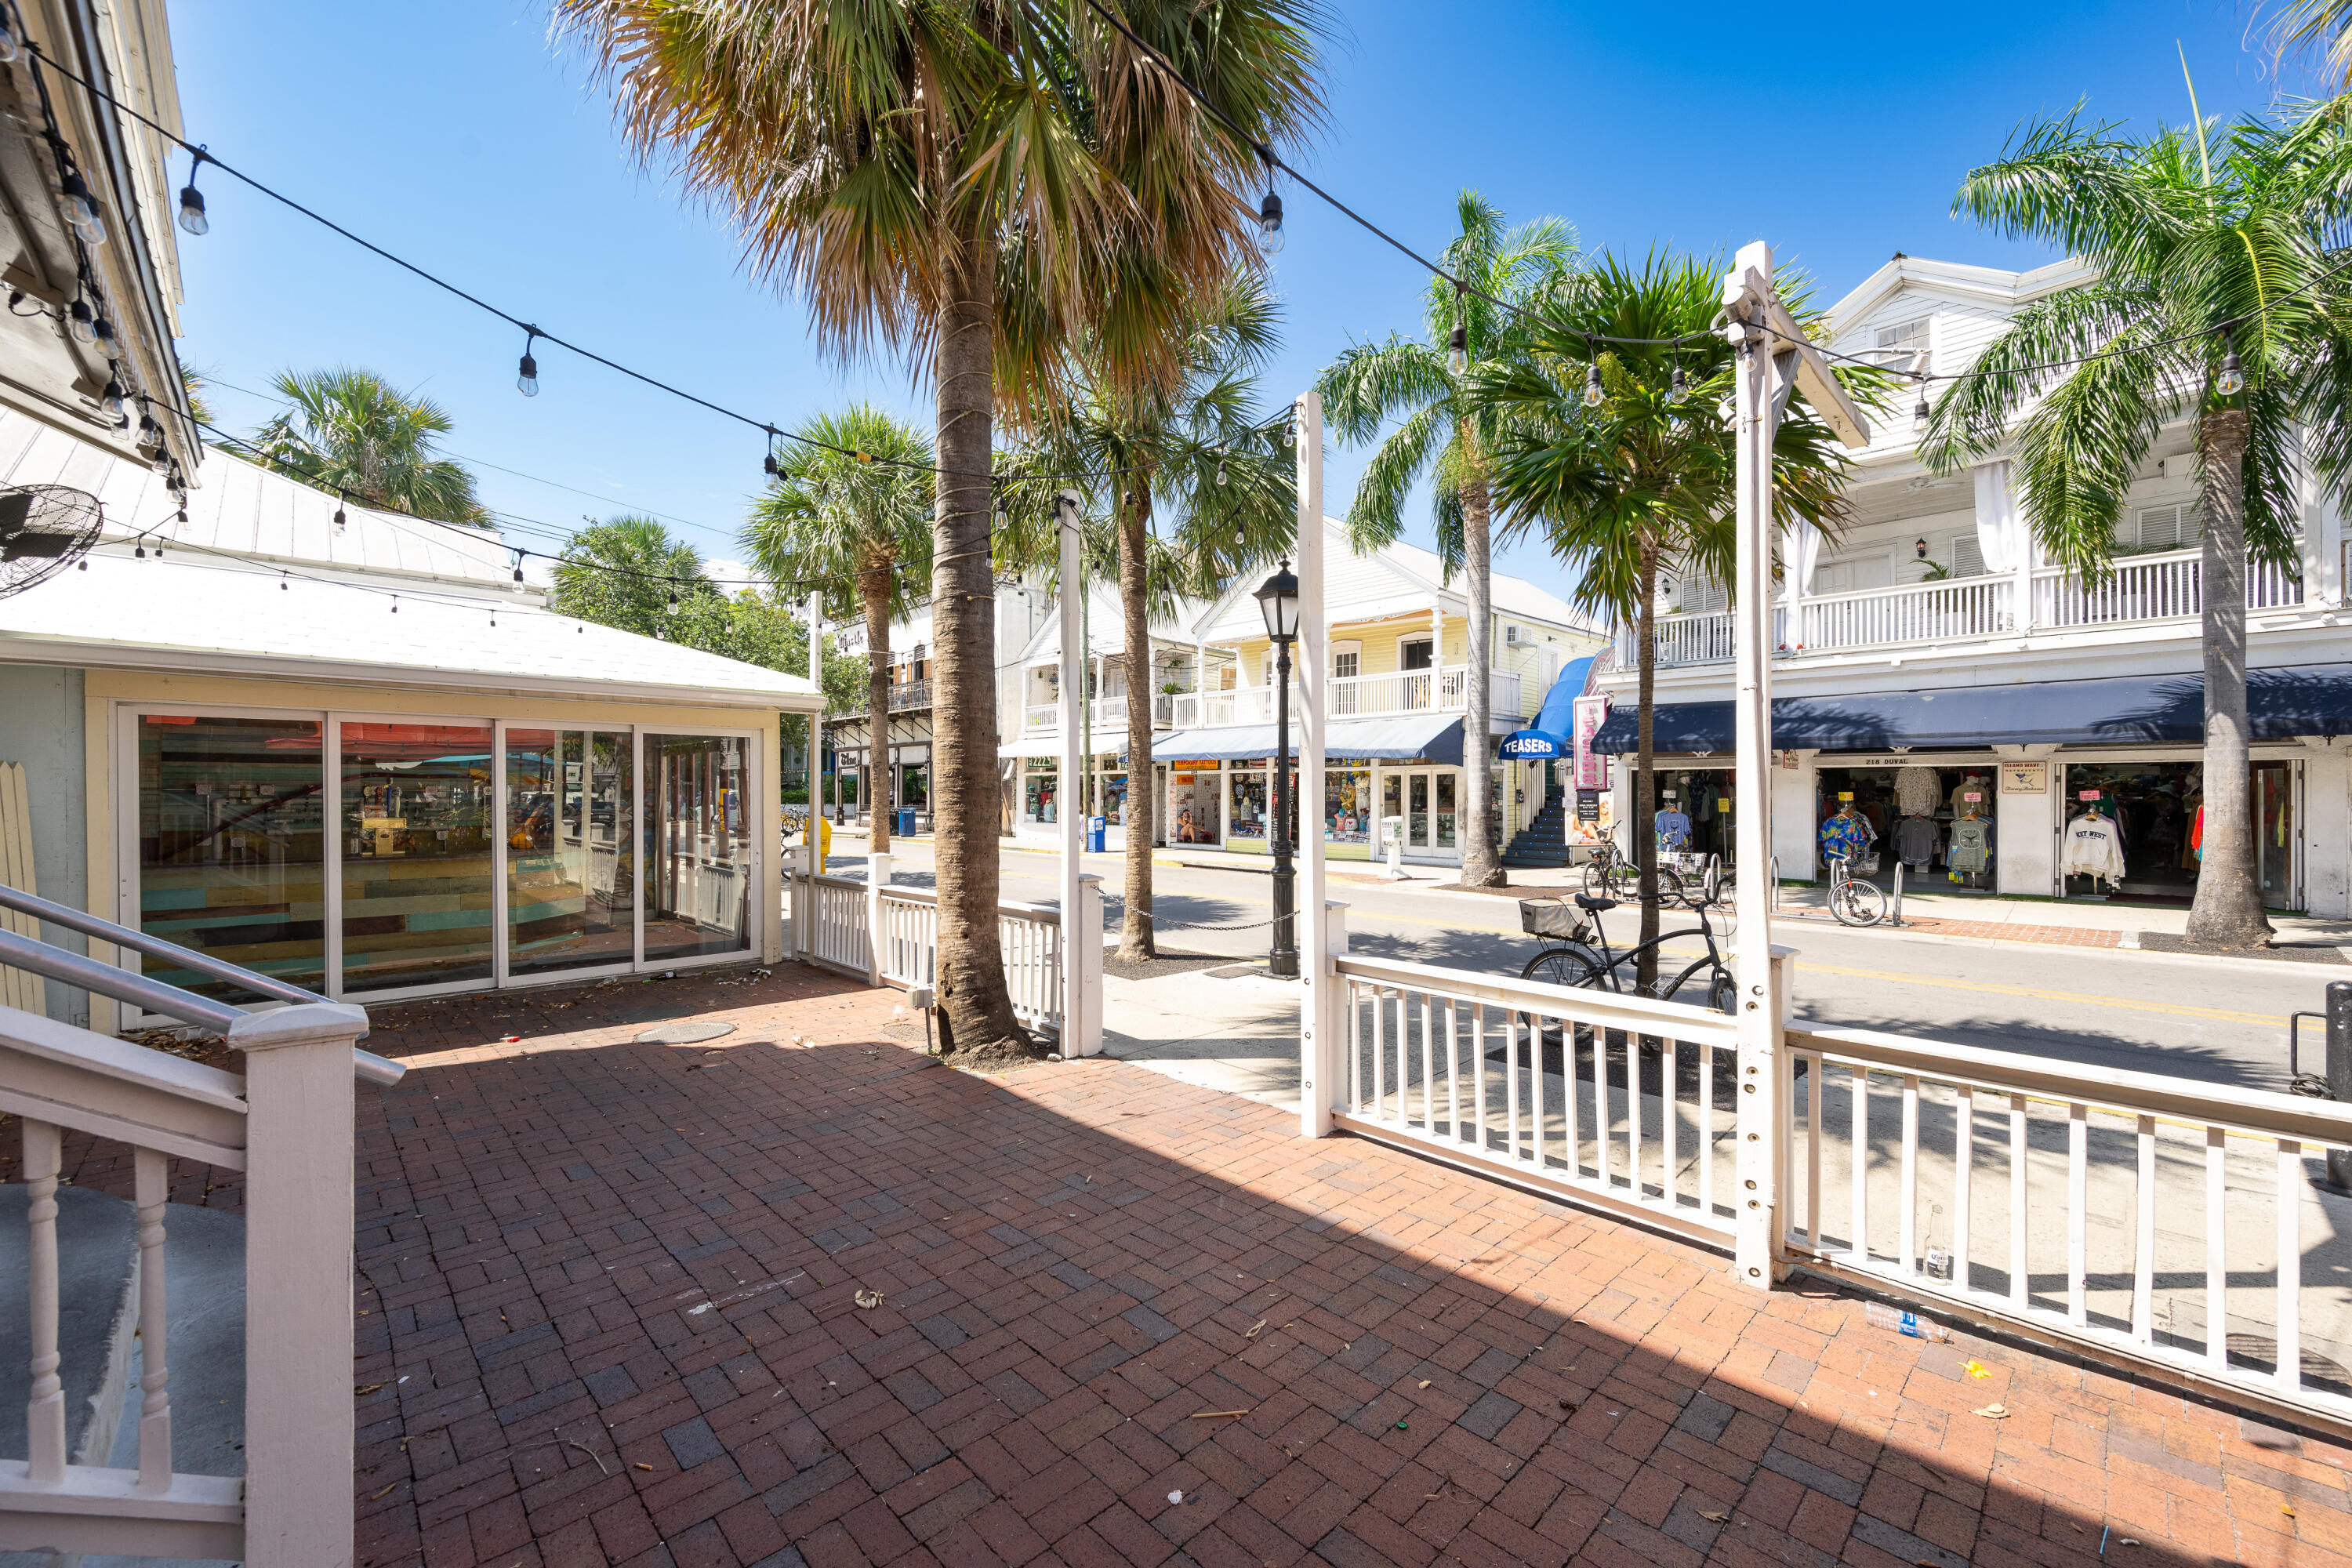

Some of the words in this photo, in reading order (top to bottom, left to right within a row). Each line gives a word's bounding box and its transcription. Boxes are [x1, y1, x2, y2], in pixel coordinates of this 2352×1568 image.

[1504, 739, 1552, 753] TEASERS
[840, 753, 857, 765] The
[2089, 830, 2107, 840] WEST
